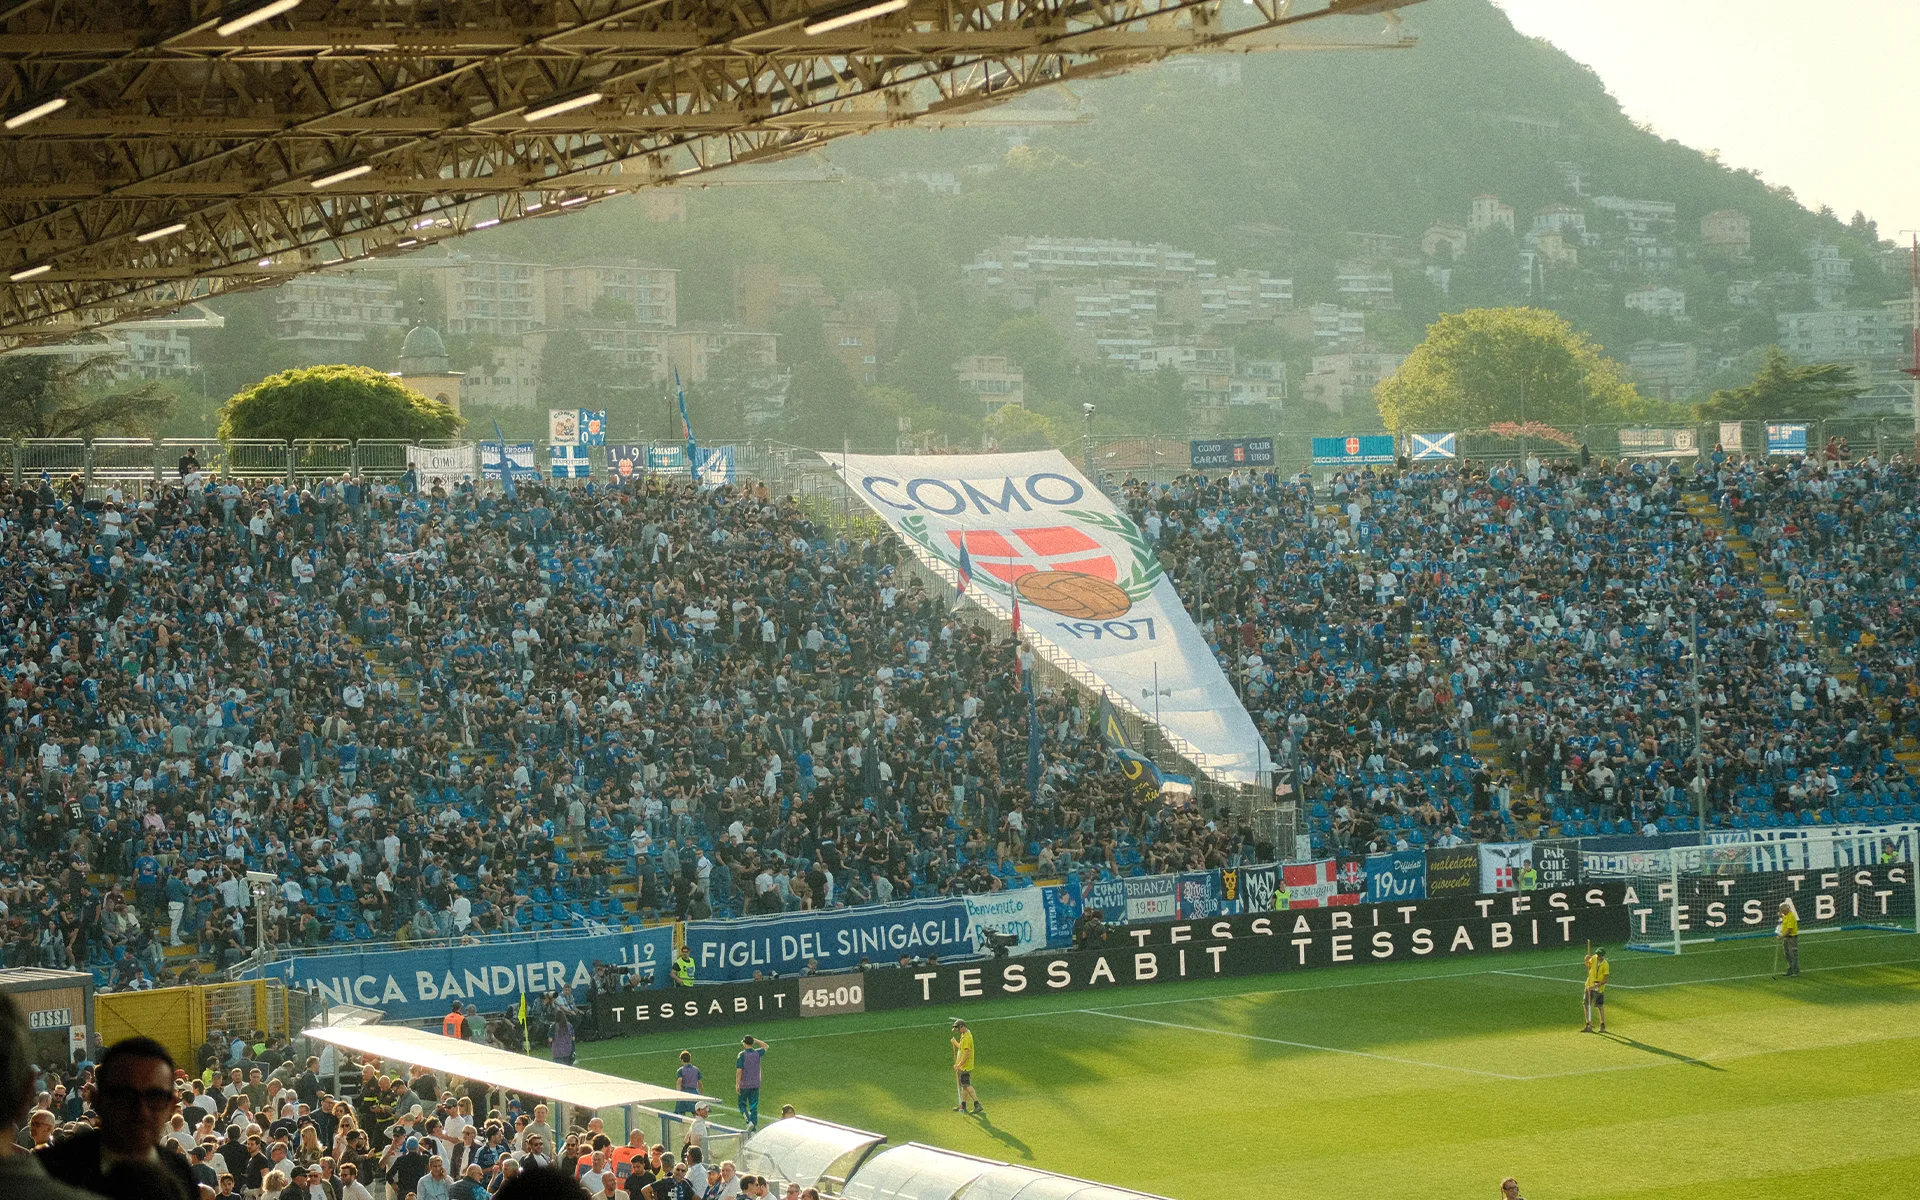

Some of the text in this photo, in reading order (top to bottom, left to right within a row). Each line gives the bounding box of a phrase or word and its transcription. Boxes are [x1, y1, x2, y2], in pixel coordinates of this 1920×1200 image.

[1249, 442, 1270, 450] CLUB
[1193, 453, 1270, 463] CARATE URIO
[1341, 455, 1362, 463] CUORE
[862, 472, 1084, 515] COMO
[1056, 617, 1156, 640] 1907
[1543, 848, 1565, 859] PAR
[1430, 855, 1477, 871] maledetta
[1543, 870, 1566, 881] CHE
[1094, 882, 1122, 896] COMO
[1126, 880, 1173, 896] BRIANZA
[1301, 885, 1333, 898] Maggio
[966, 898, 1023, 916] Benvenuto
[1085, 894, 1123, 909] MCMVII
[1136, 900, 1168, 914] 19 07
[1045, 889, 1058, 937] VETERANI
[1634, 890, 1893, 934] TESSABIT
[975, 920, 1032, 944] RARDO
[1291, 915, 1576, 965] TESSABIT
[643, 943, 655, 960] 9
[701, 917, 975, 968] FIGLI DEL SINIGAGLIA
[416, 959, 592, 1000] BANDIERA
[914, 946, 1227, 1000] TESSABIT
[801, 985, 863, 1008] 45:00
[612, 993, 786, 1022] TESSABIT
[31, 1009, 69, 1027] CASSA
